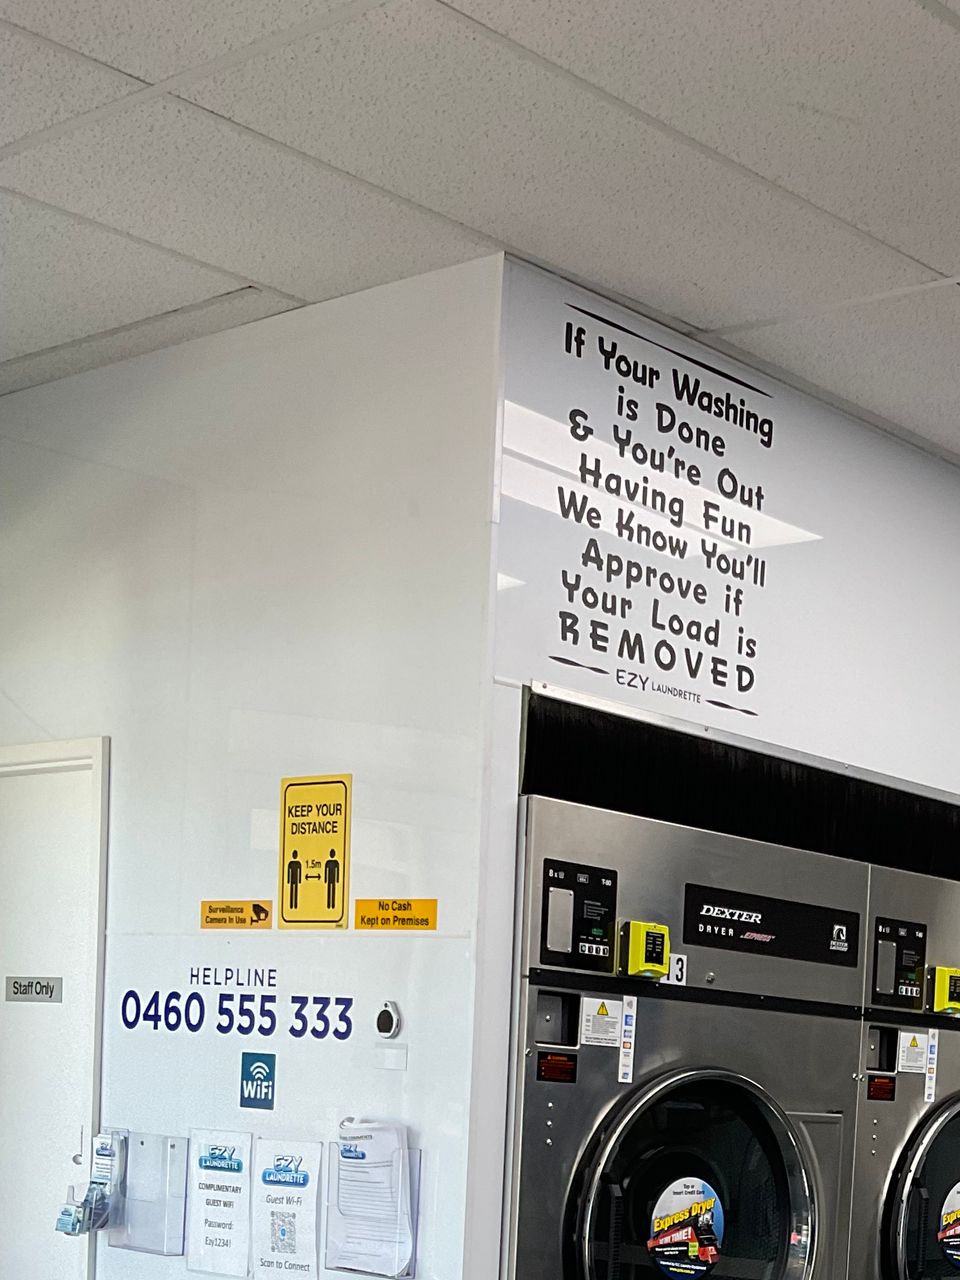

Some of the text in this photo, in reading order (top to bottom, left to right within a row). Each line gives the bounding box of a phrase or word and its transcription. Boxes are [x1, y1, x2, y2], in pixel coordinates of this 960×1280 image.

[564, 321, 774, 449] If Your Washing
[617, 385, 726, 457] is Done
[568, 408, 765, 512] & You're Out
[578, 453, 751, 544] Having Fun
[557, 486, 766, 587] We Know You'll
[582, 538, 743, 616] Approve if
[561, 569, 757, 659] Your Load is
[559, 610, 755, 692] REMOVED
[615, 668, 701, 704] EZY LAUNDRETTE
[288, 803, 342, 818] KEEP YOUR
[291, 820, 338, 835] DISTANCE
[305, 859, 322, 869] 1.5m
[208, 905, 244, 914] Surveillance
[379, 901, 412, 911] No Cash
[700, 905, 762, 924] DEXTER
[205, 916, 227, 924] Camera
[235, 916, 247, 924] Use
[361, 915, 429, 928] Kept on Premises
[698, 924, 734, 937] DRYER
[190, 967, 277, 987] HELPLINE
[13, 980, 55, 998] Staff Only
[121, 990, 354, 1040] 0460 555 333
[243, 1080, 272, 1100] WiFi
[273, 1154, 303, 1173] EZY
[198, 1182, 242, 1194] COMPLIMENTARY
[205, 1198, 222, 1207] GUEST
[266, 1194, 284, 1205] Guest
[653, 1197, 716, 1232] Express Dryer
[260, 1258, 310, 1272] Scan to Connect
